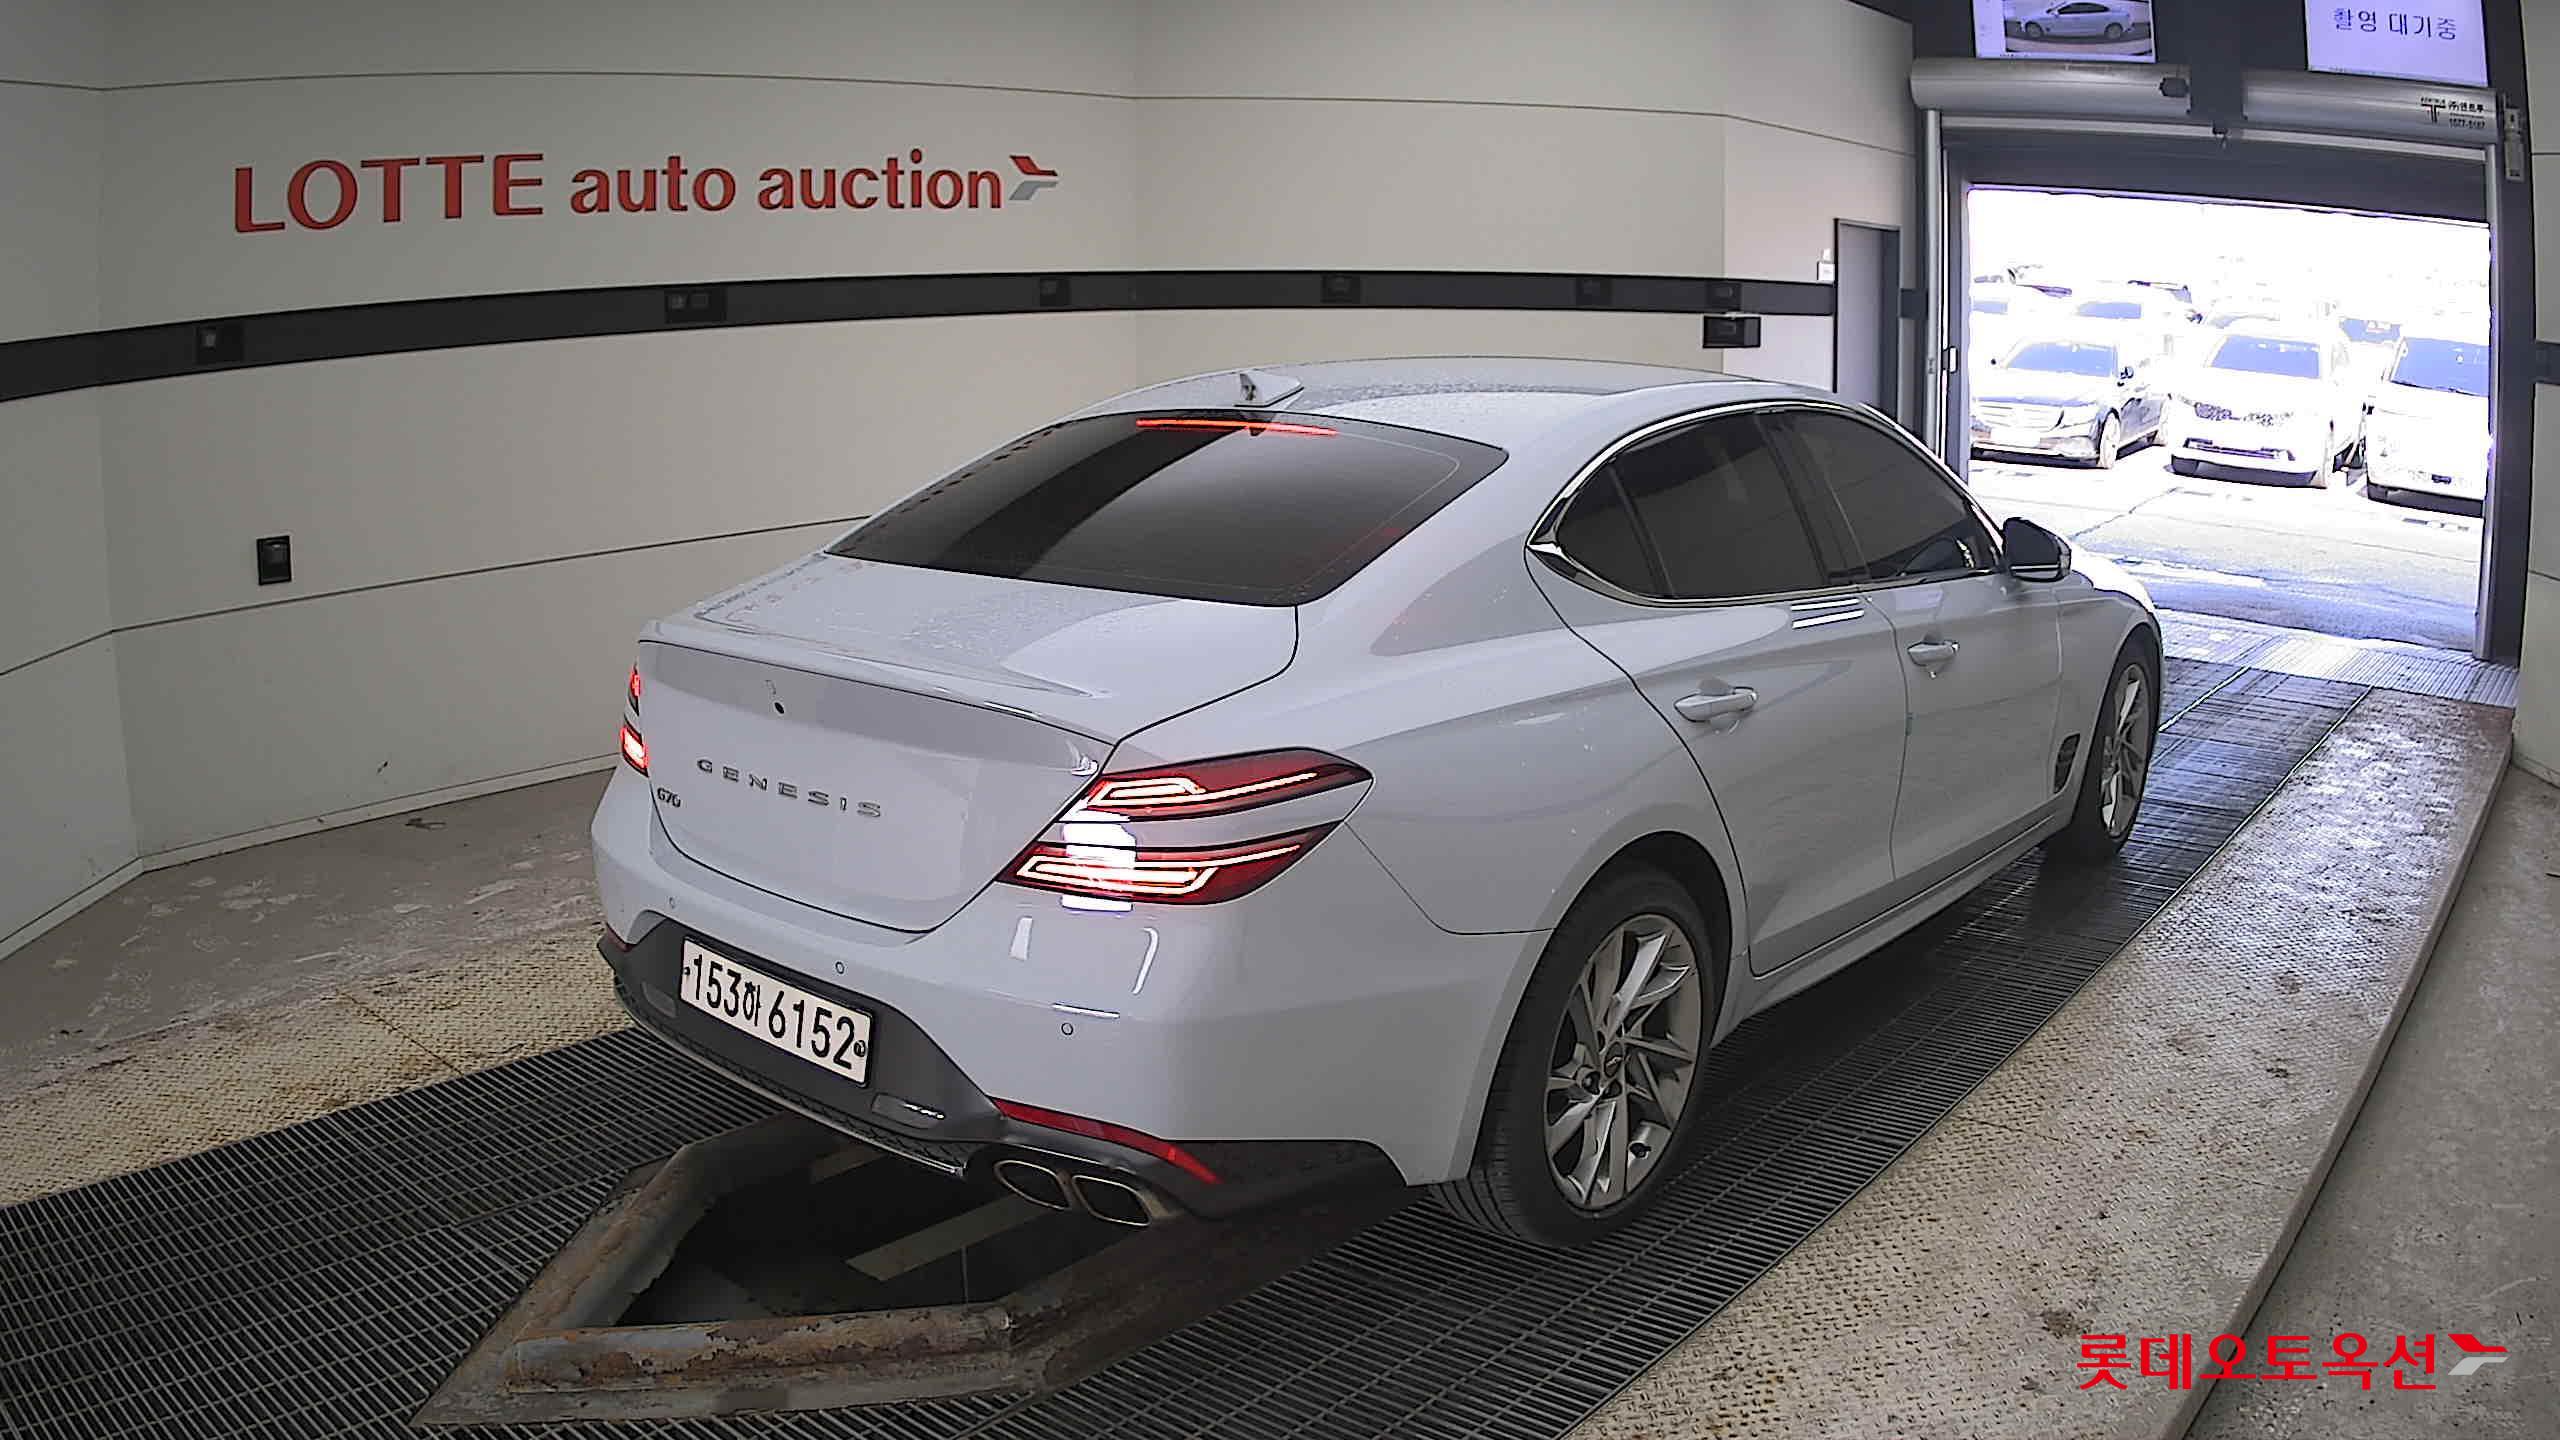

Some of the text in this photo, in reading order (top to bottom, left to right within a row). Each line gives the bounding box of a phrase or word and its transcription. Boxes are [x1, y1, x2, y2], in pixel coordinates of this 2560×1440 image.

[2388, 13, 2457, 40] 대기중
[234, 148, 1002, 232] LOTTE auto auction
[657, 787, 682, 808] G70
[697, 759, 881, 818] GENESIS
